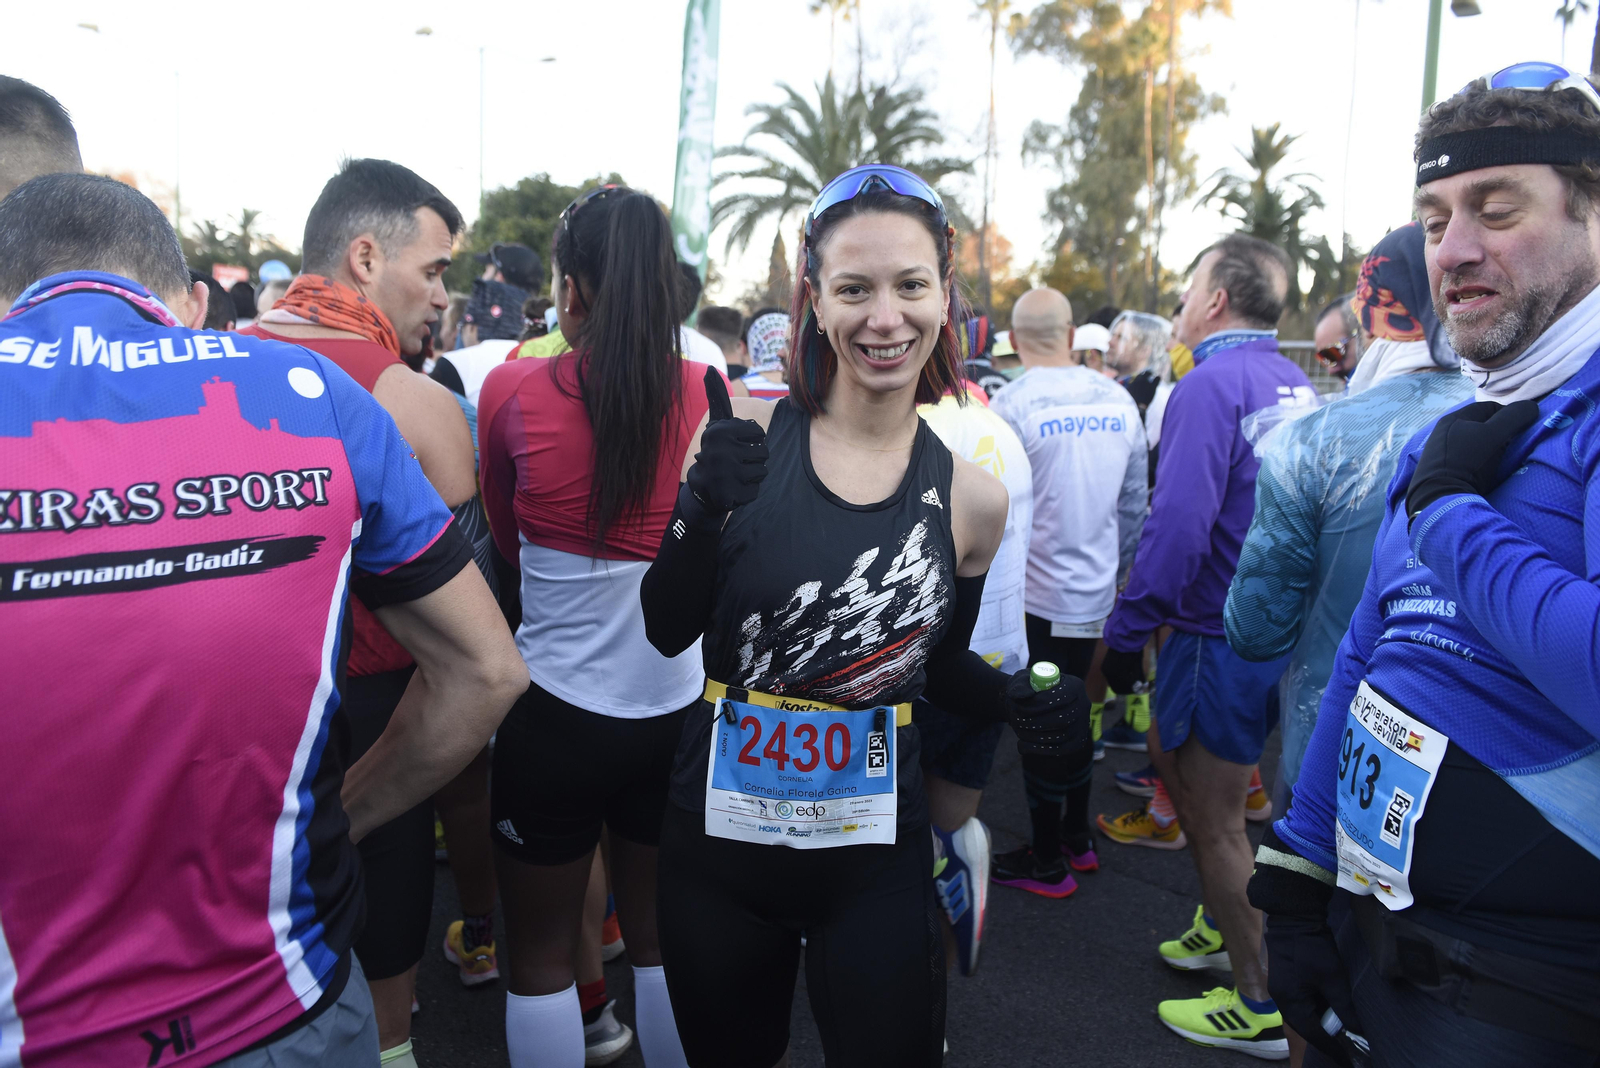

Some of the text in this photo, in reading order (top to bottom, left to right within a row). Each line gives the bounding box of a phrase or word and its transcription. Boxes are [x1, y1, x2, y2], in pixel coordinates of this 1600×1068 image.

[70, 326, 250, 372] MIGUEL
[1040, 413, 1127, 437] mayoral
[174, 468, 332, 519] SPORT
[12, 544, 266, 591] Fernando-Cadiz
[1402, 583, 1432, 596] CUÑAS
[1371, 702, 1408, 738] maratón
[738, 716, 851, 772] 2430
[1373, 721, 1405, 752] sevilla
[778, 775, 813, 783] CORNELIA
[1339, 728, 1381, 810] 913
[744, 782, 858, 798] Cornelia Florela Gaina
[796, 802, 826, 820] edp
[758, 825, 782, 833] HOKA
